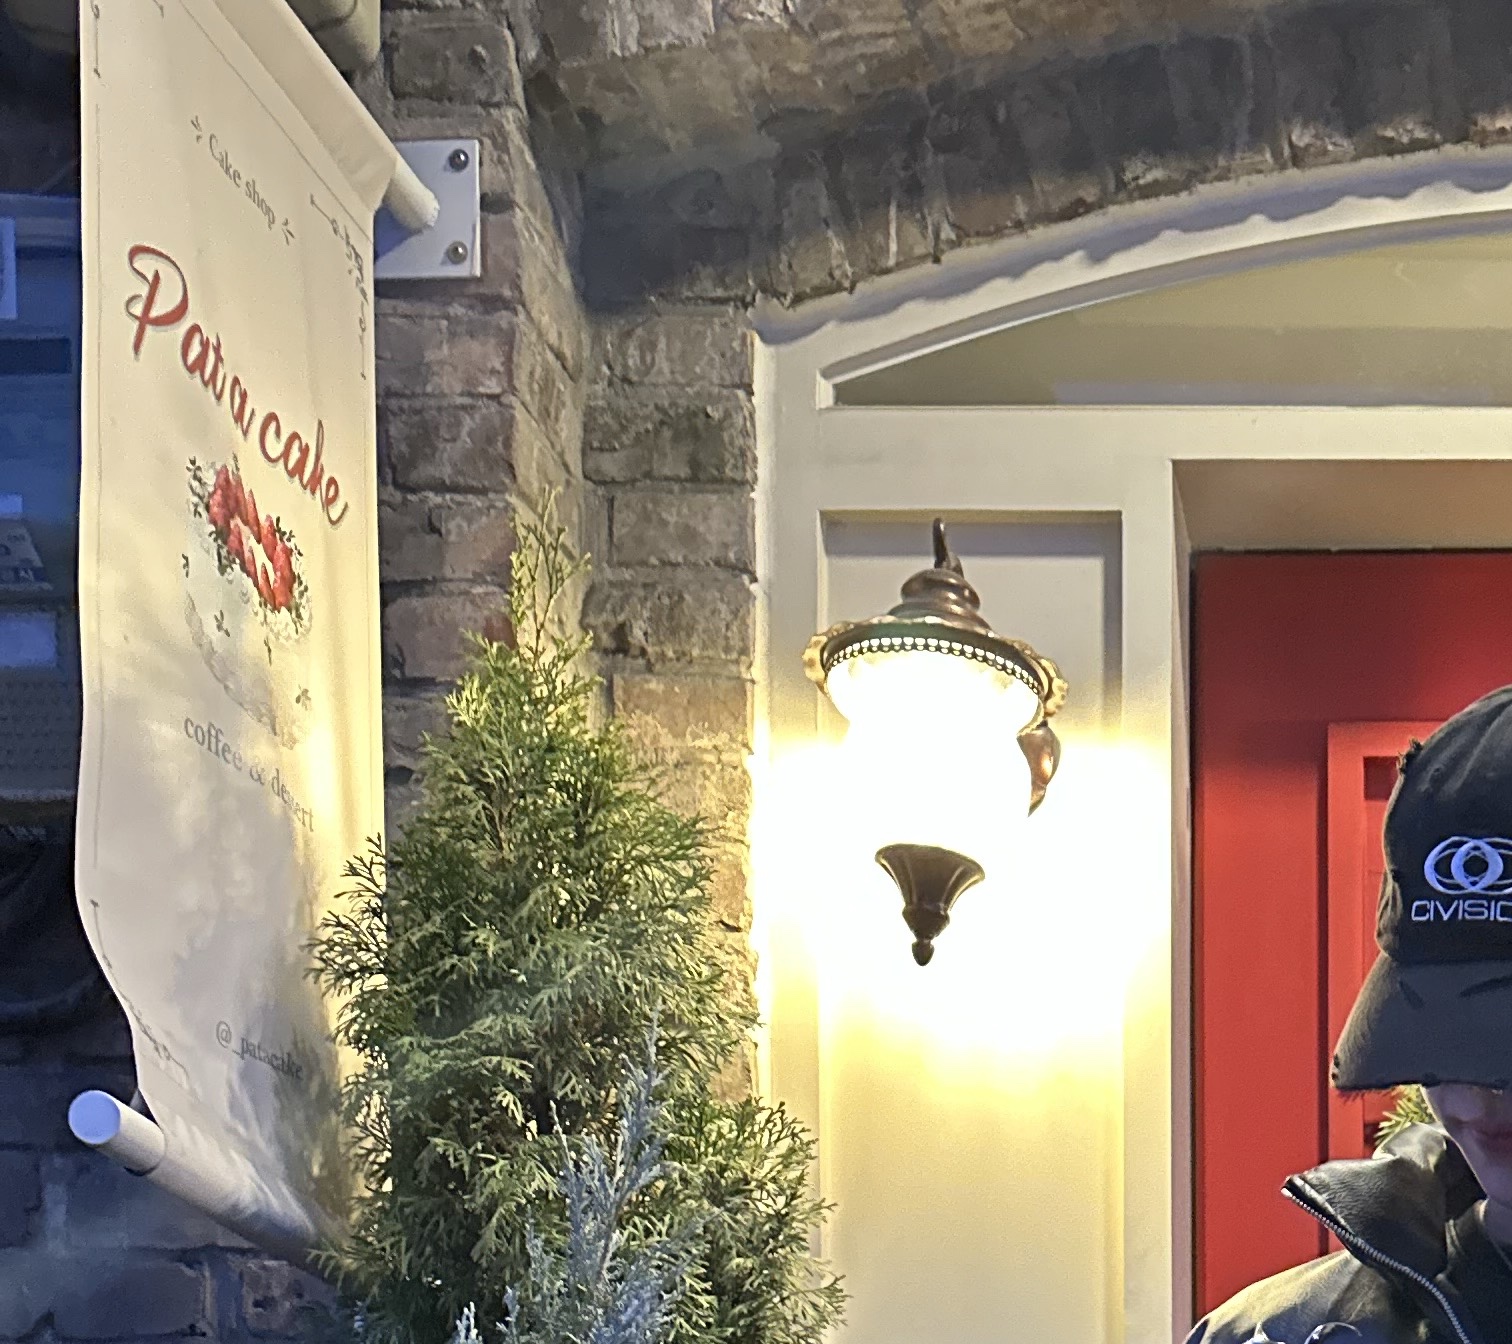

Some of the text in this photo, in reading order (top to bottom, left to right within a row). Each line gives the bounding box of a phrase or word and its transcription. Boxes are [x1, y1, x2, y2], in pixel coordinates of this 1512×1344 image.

[208, 133, 276, 230] Cake shop
[126, 243, 349, 525] Pat a cake
[184, 717, 243, 771] coffee
